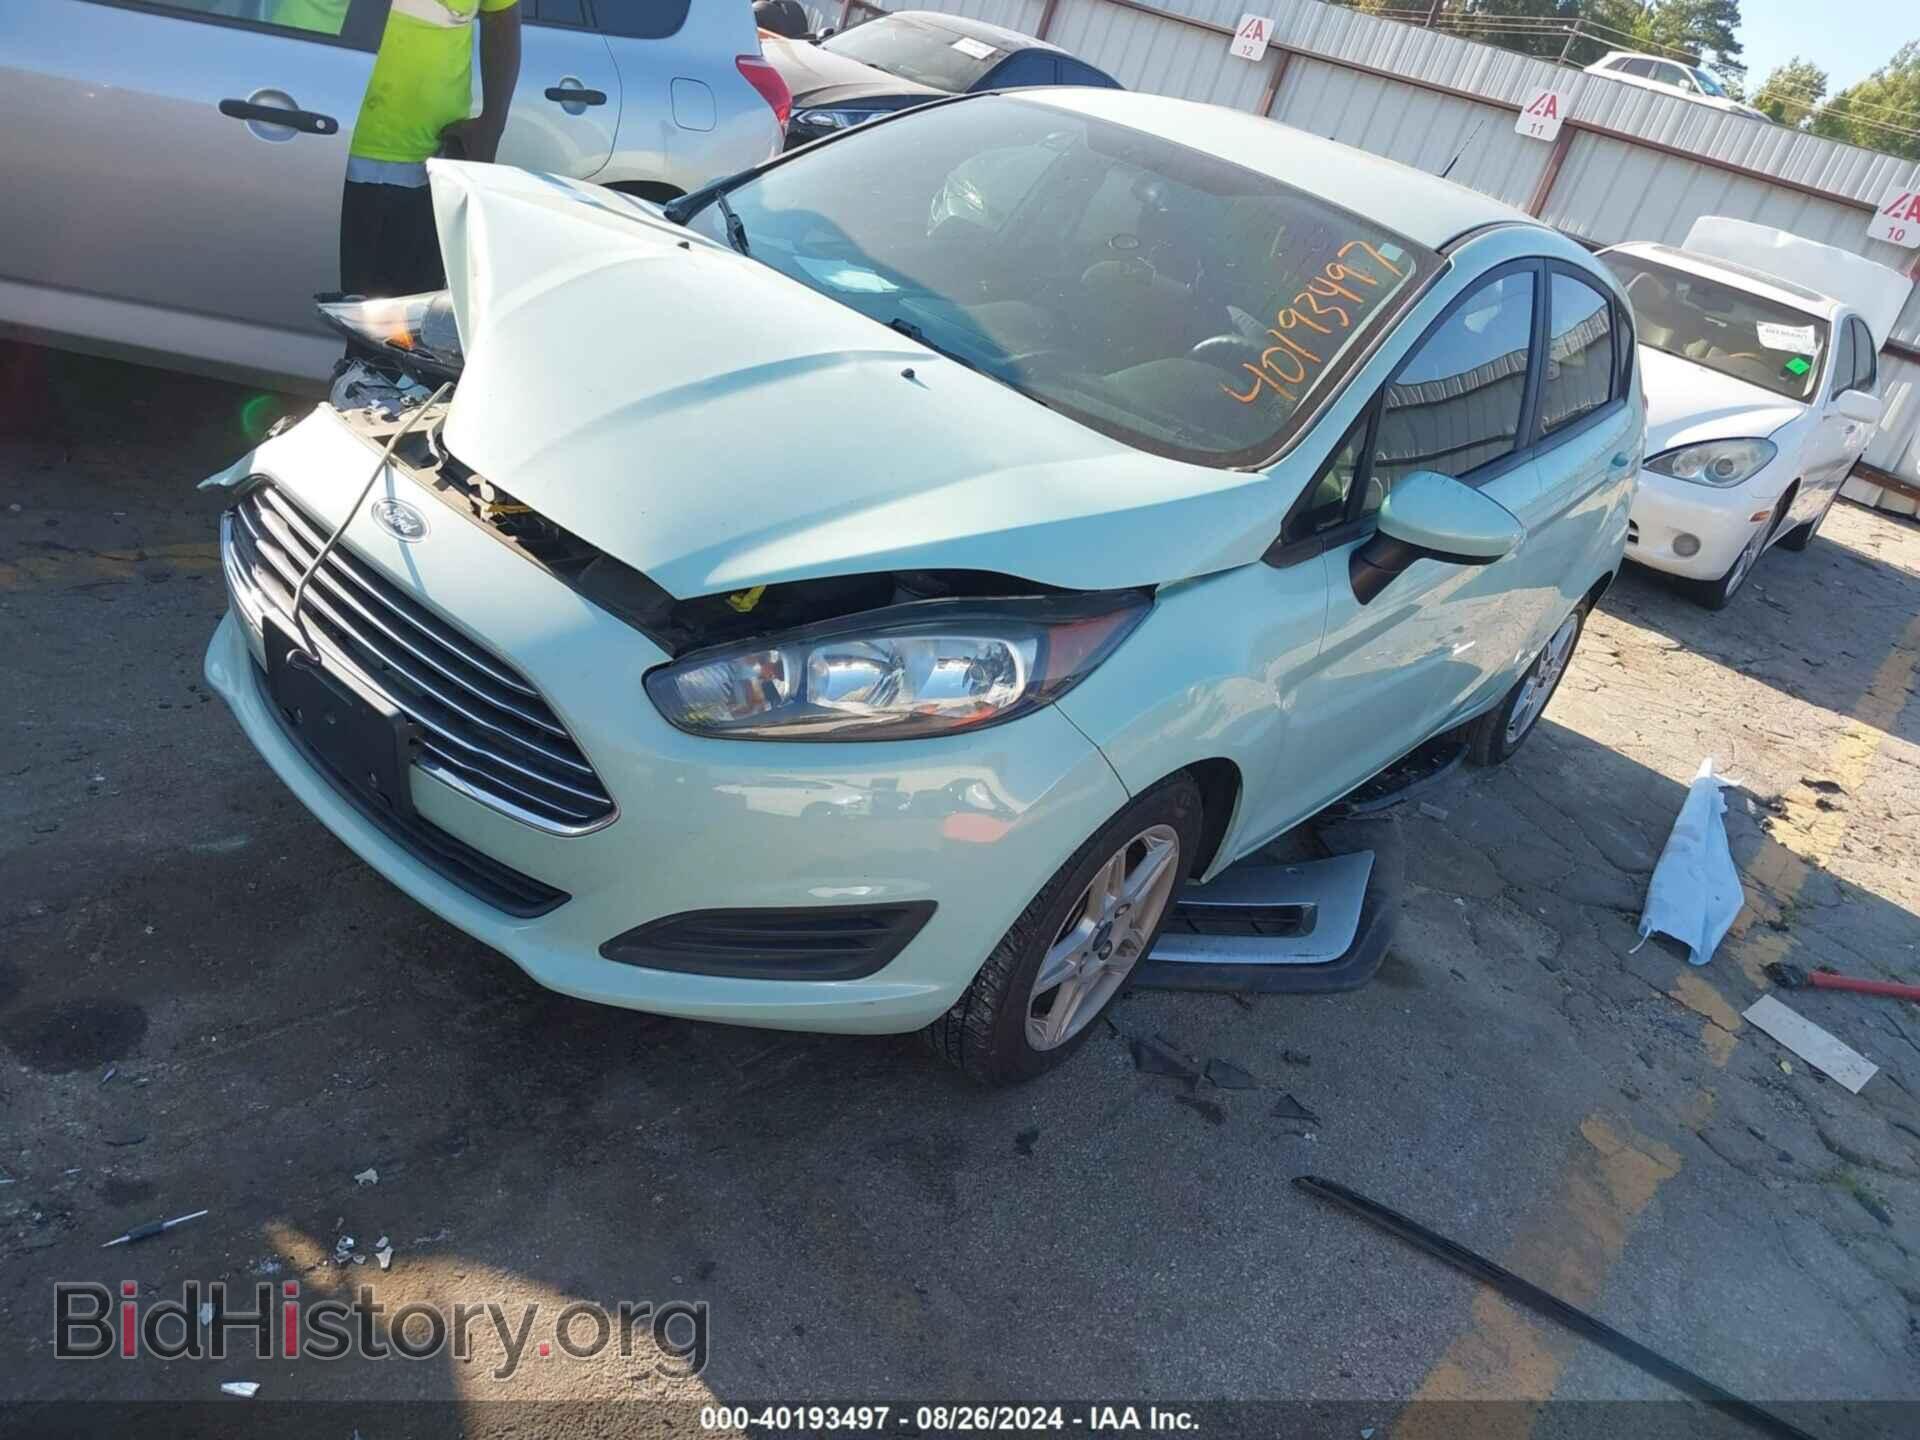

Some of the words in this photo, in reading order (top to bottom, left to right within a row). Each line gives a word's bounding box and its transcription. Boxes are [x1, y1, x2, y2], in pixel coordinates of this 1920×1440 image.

[1242, 45, 1255, 56] 12
[1530, 123, 1544, 136] 11
[1887, 226, 1906, 242] 10
[1221, 240, 1403, 404] 40193497
